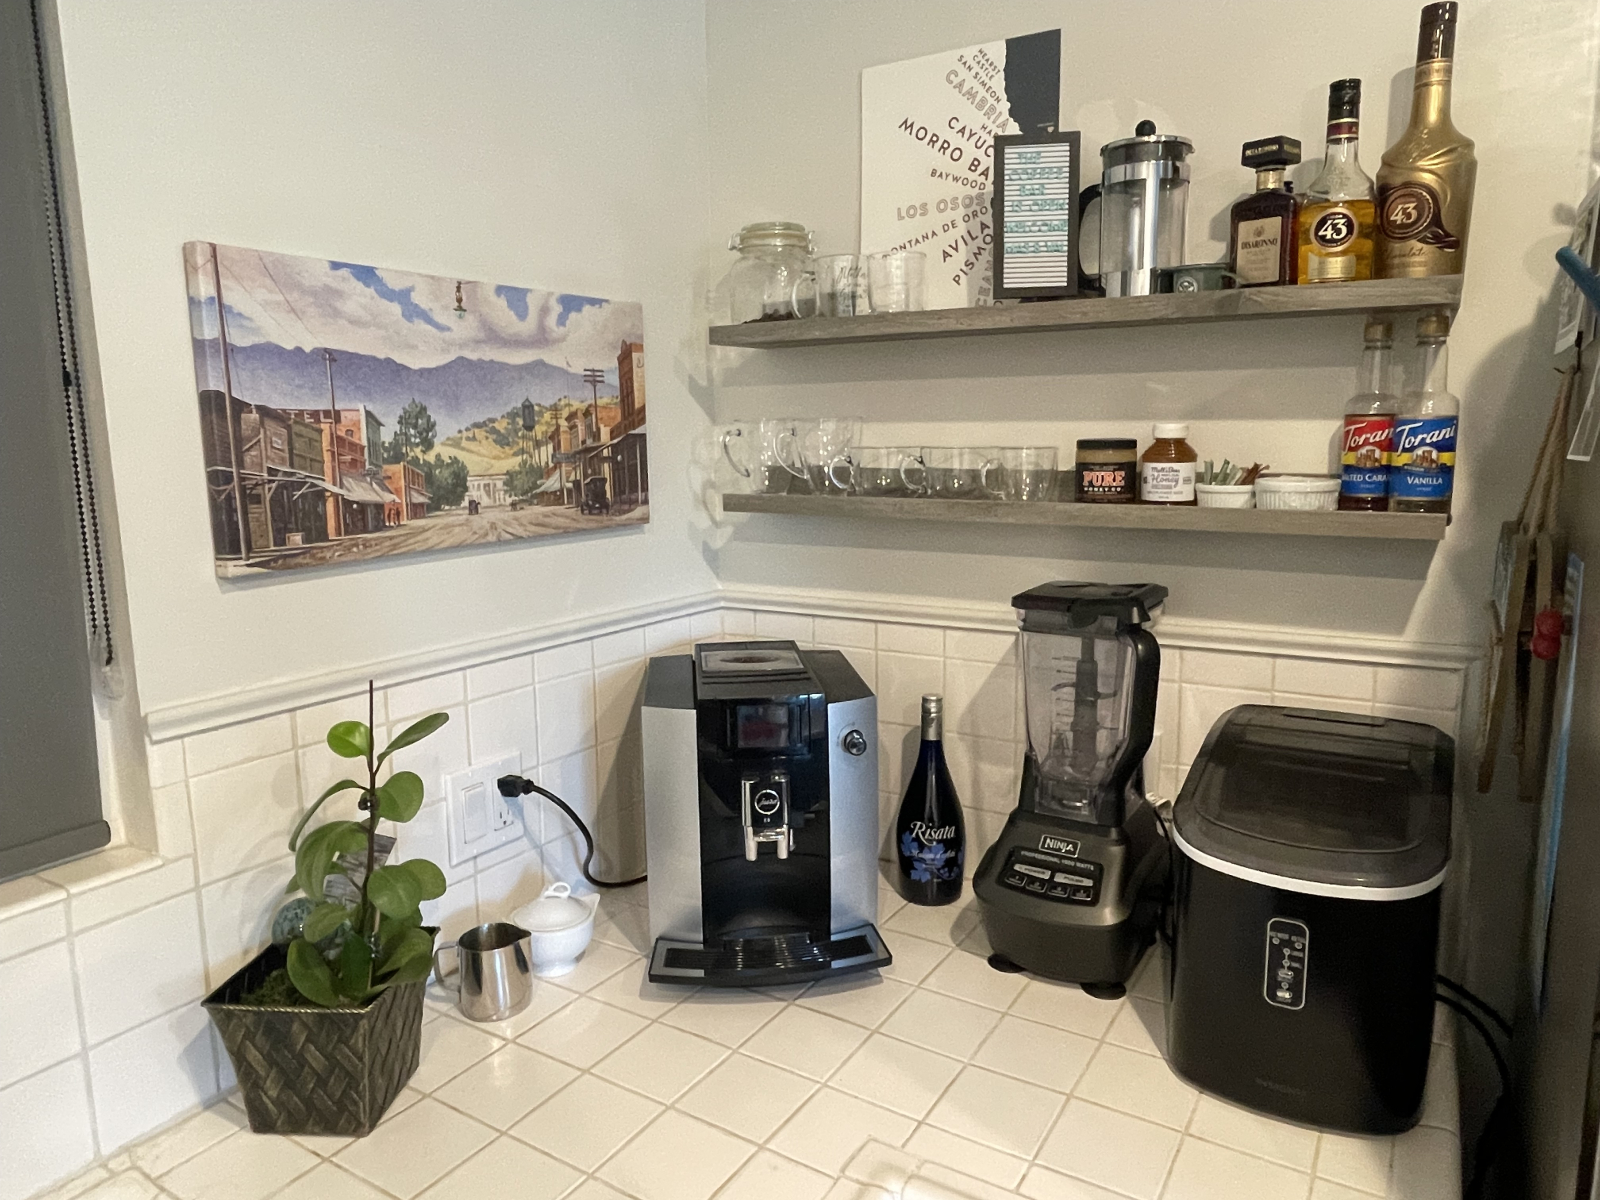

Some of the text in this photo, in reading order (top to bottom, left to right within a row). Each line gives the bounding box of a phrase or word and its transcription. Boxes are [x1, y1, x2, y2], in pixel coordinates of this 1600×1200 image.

[972, 55, 995, 82] CASTLE
[978, 48, 1001, 76] HEARST
[957, 55, 1002, 104] SAN SIMEON
[945, 69, 1010, 133] CAMBRIA
[898, 117, 994, 186] MORRO BA
[930, 168, 986, 191] BAYWOOD
[897, 192, 986, 221] LOS OSOS
[942, 219, 958, 234] DE
[962, 205, 988, 224] ORO
[1390, 202, 1418, 225] 43
[941, 220, 991, 263] AVILA
[1318, 219, 1347, 239] 43
[1241, 237, 1278, 250] DISARONNO
[952, 233, 993, 286] PISMO
[277, 409, 334, 424] TEL
[1396, 421, 1456, 457] Torani
[1082, 471, 1126, 487] PURE
[1407, 476, 1443, 485] VANILLA
[910, 821, 956, 846] Risata
[1045, 838, 1074, 853] NINJA
